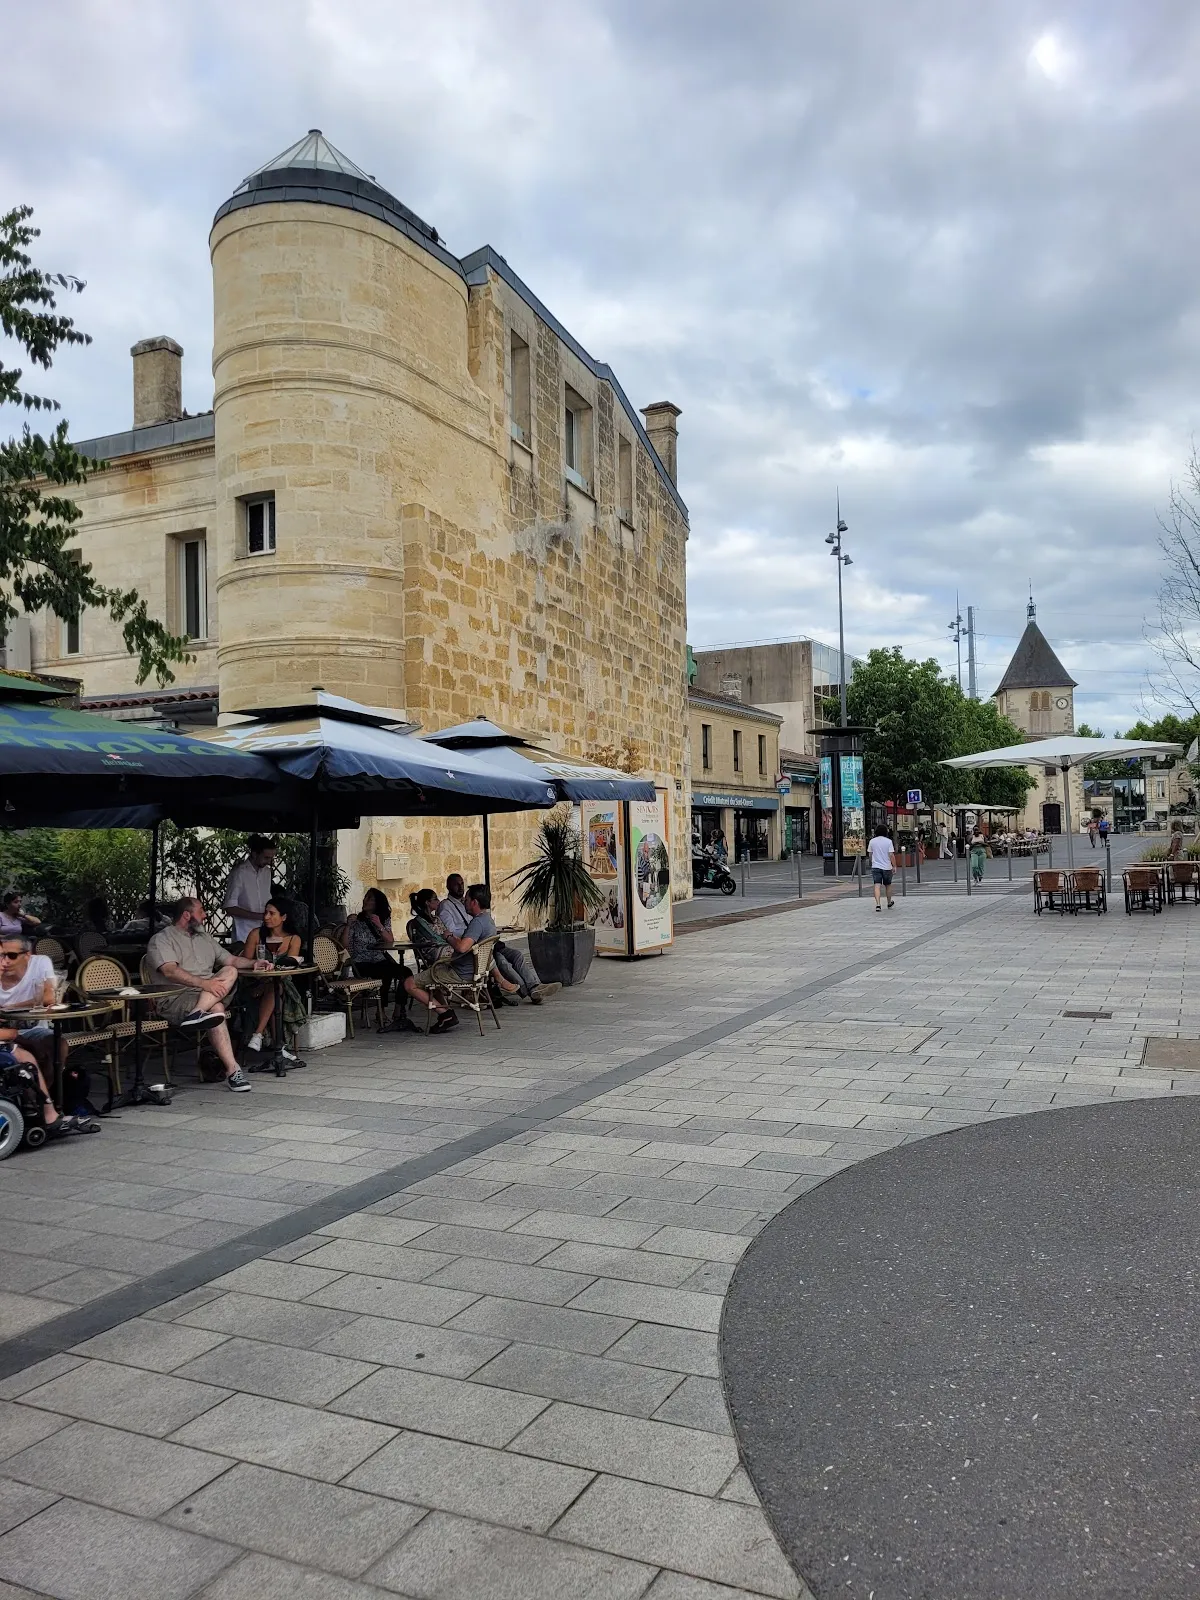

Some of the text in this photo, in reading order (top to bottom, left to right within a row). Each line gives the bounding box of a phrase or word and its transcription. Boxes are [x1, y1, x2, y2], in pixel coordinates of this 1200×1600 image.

[101, 759, 144, 767] Heineken
[703, 795, 715, 805] Crédit
[716, 797, 729, 806] Mutuel
